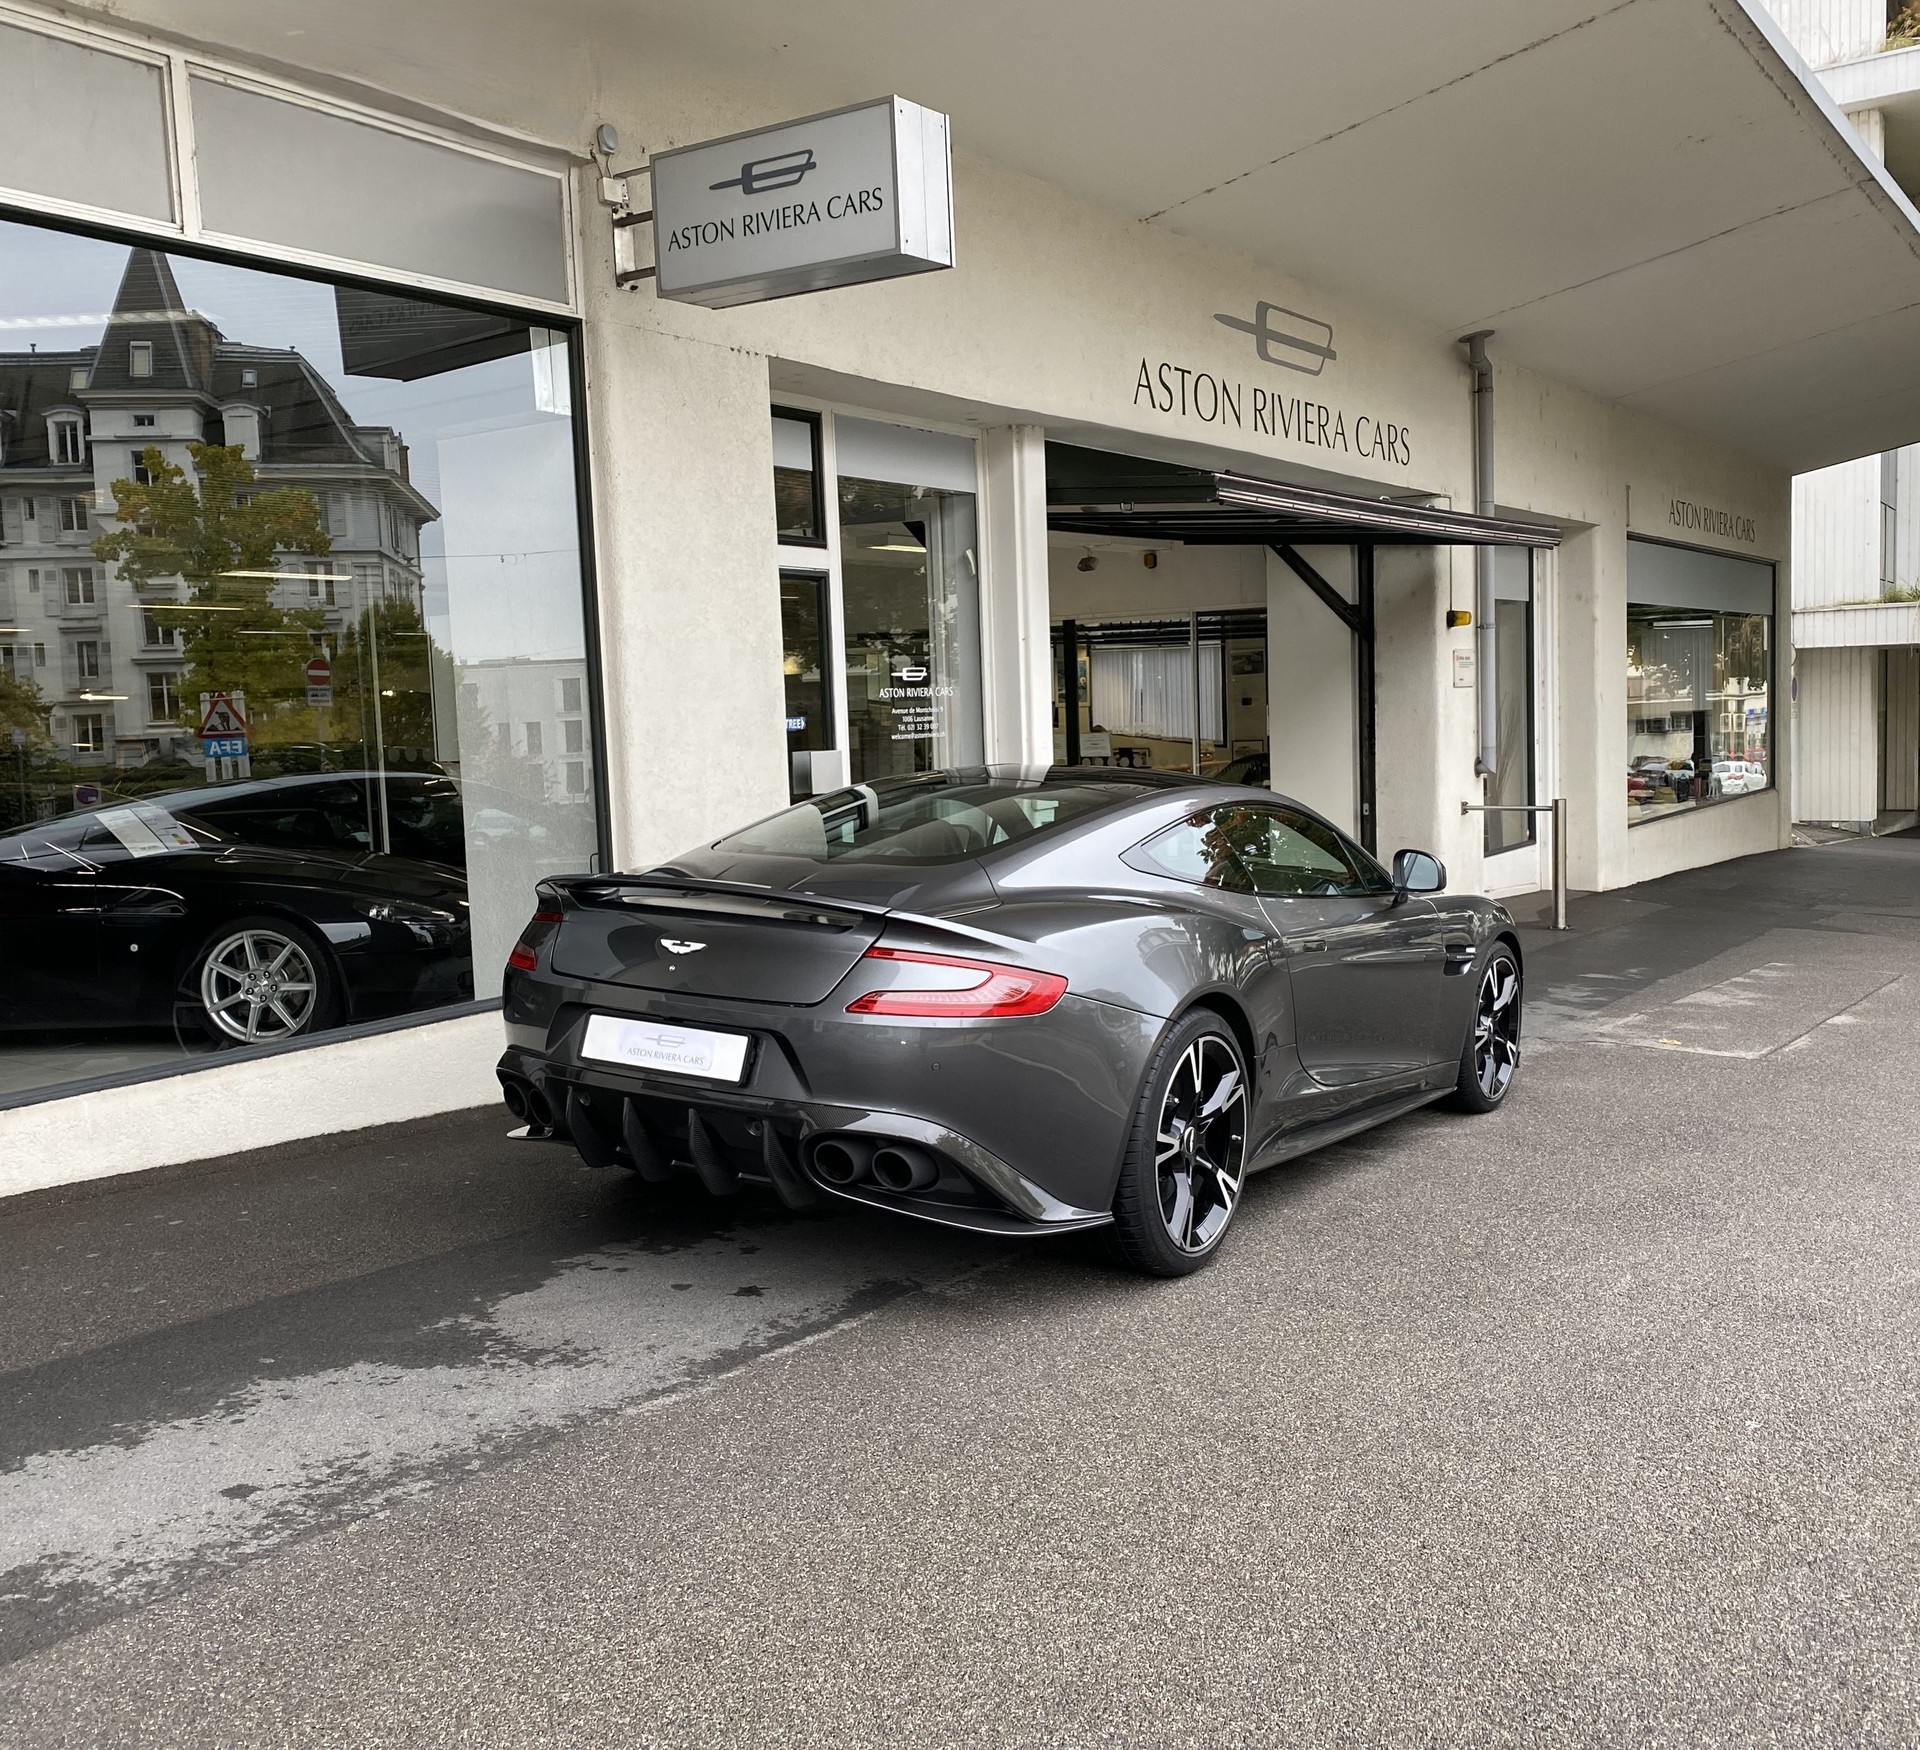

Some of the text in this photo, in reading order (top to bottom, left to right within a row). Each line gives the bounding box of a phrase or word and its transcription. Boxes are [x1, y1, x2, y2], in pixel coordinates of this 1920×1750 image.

[668, 187, 884, 252] ASTON RIVIERA CARS
[1133, 357, 1411, 466] ASTON RIVIERA CARS
[1669, 499, 1756, 543] ASTON RIVIERA CARS
[879, 686, 954, 698] ASTON RIVIERA CARS
[627, 1047, 704, 1066] ASTON RIVIERA CARS
